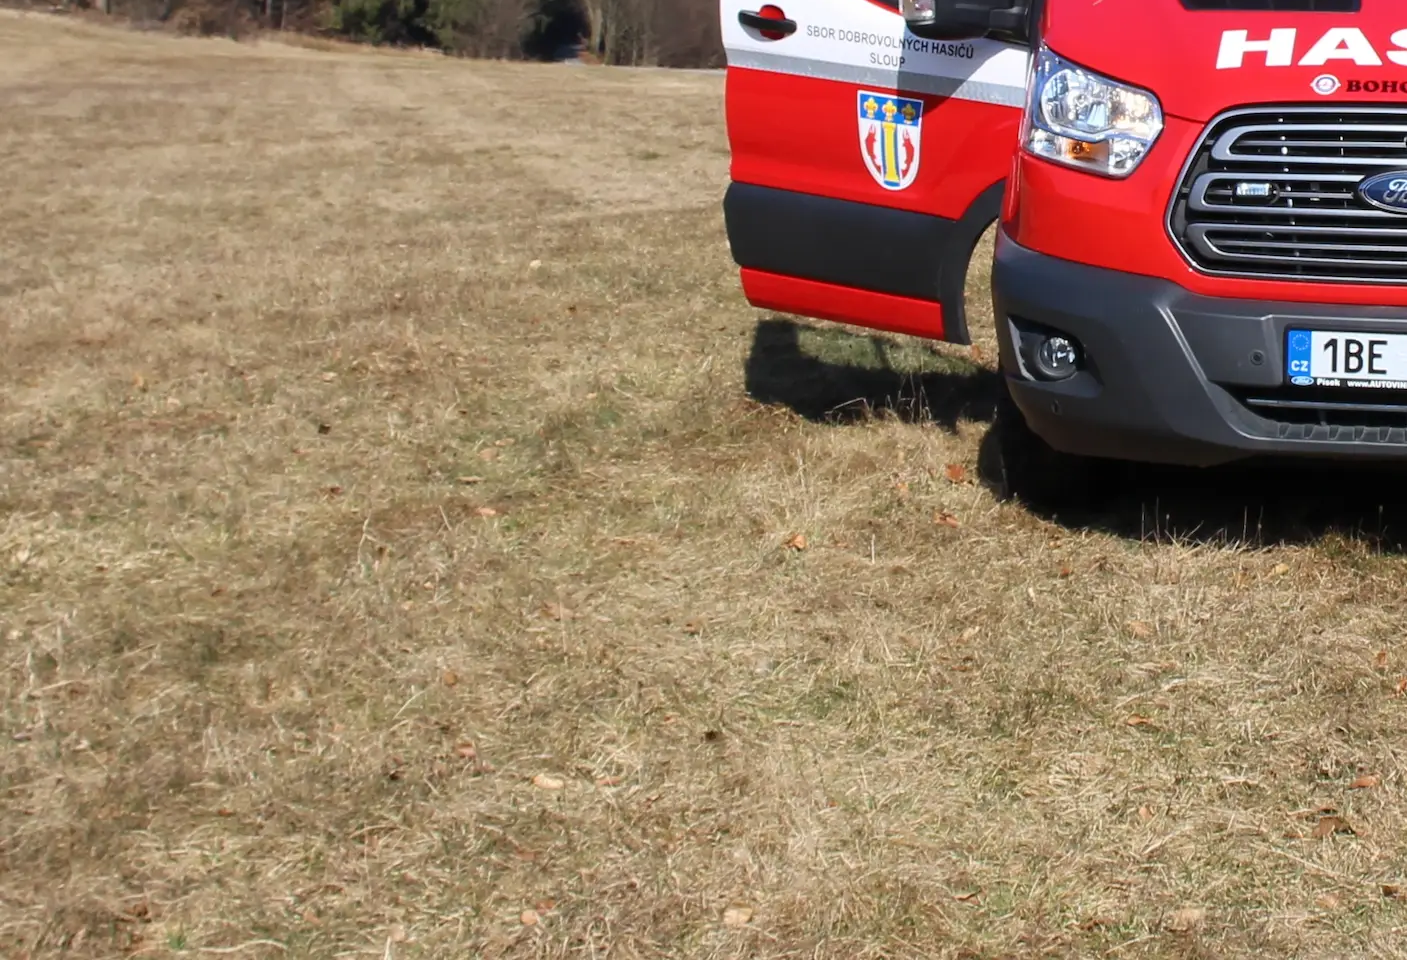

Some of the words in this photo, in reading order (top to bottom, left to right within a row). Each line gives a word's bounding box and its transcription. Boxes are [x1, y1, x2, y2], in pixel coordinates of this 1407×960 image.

[807, 25, 835, 40] SBOR
[838, 29, 929, 53] DOBROVOLNÝCH
[931, 41, 974, 59] HASIČŮ
[870, 52, 906, 68] SLOUP
[1291, 360, 1309, 373] CZ
[1323, 338, 1388, 375] 1BE
